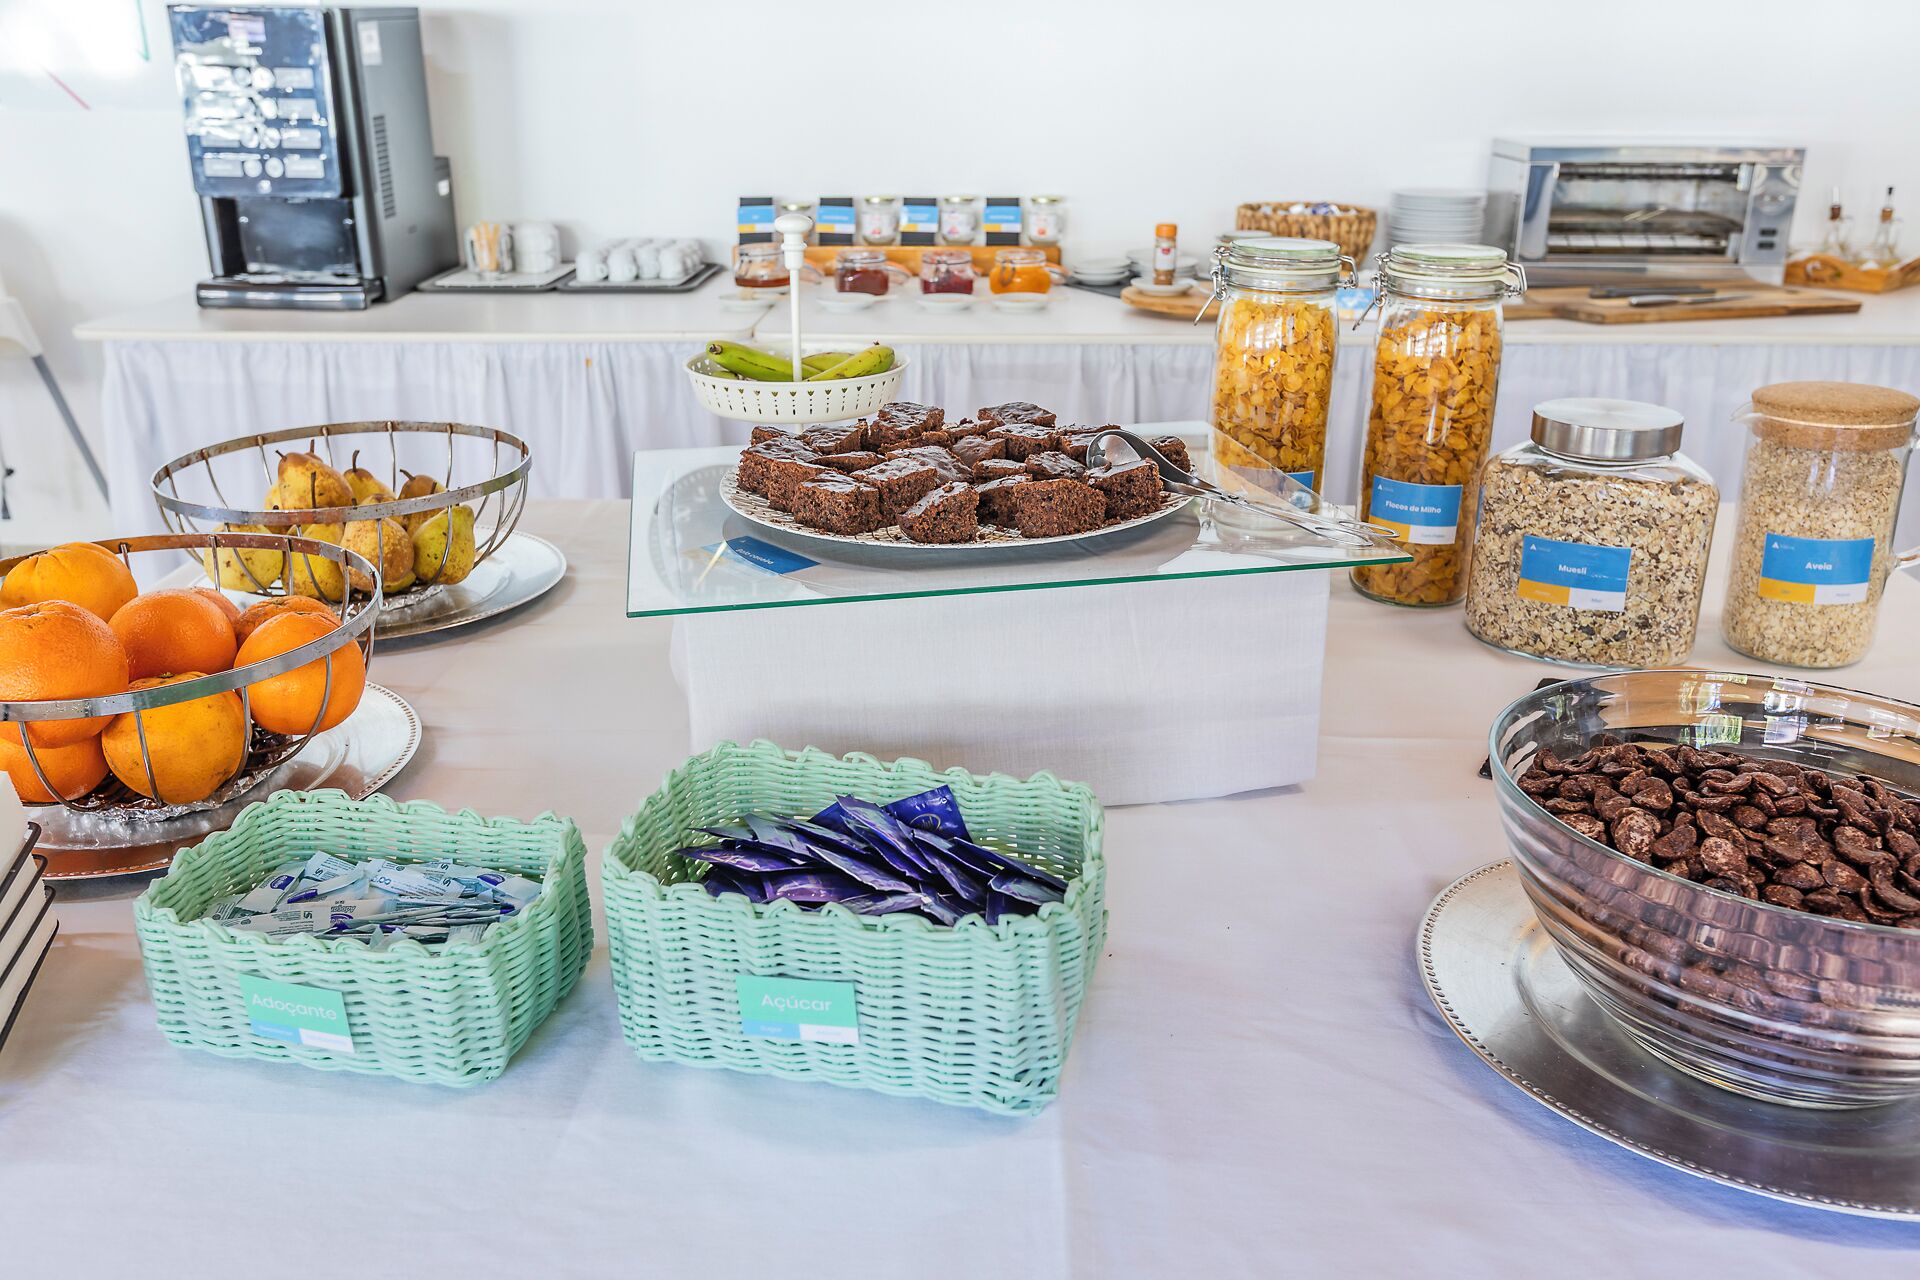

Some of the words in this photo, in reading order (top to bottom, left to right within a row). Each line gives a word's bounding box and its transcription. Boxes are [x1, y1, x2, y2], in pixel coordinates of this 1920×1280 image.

[1385, 500, 1408, 511] Flocos
[1409, 504, 1420, 513] de
[1420, 506, 1442, 514] Milho
[1558, 564, 1587, 575] Muesli
[1804, 561, 1833, 571] Aveia
[251, 993, 338, 1020] Adoçante
[760, 993, 833, 1013] Açúcar
